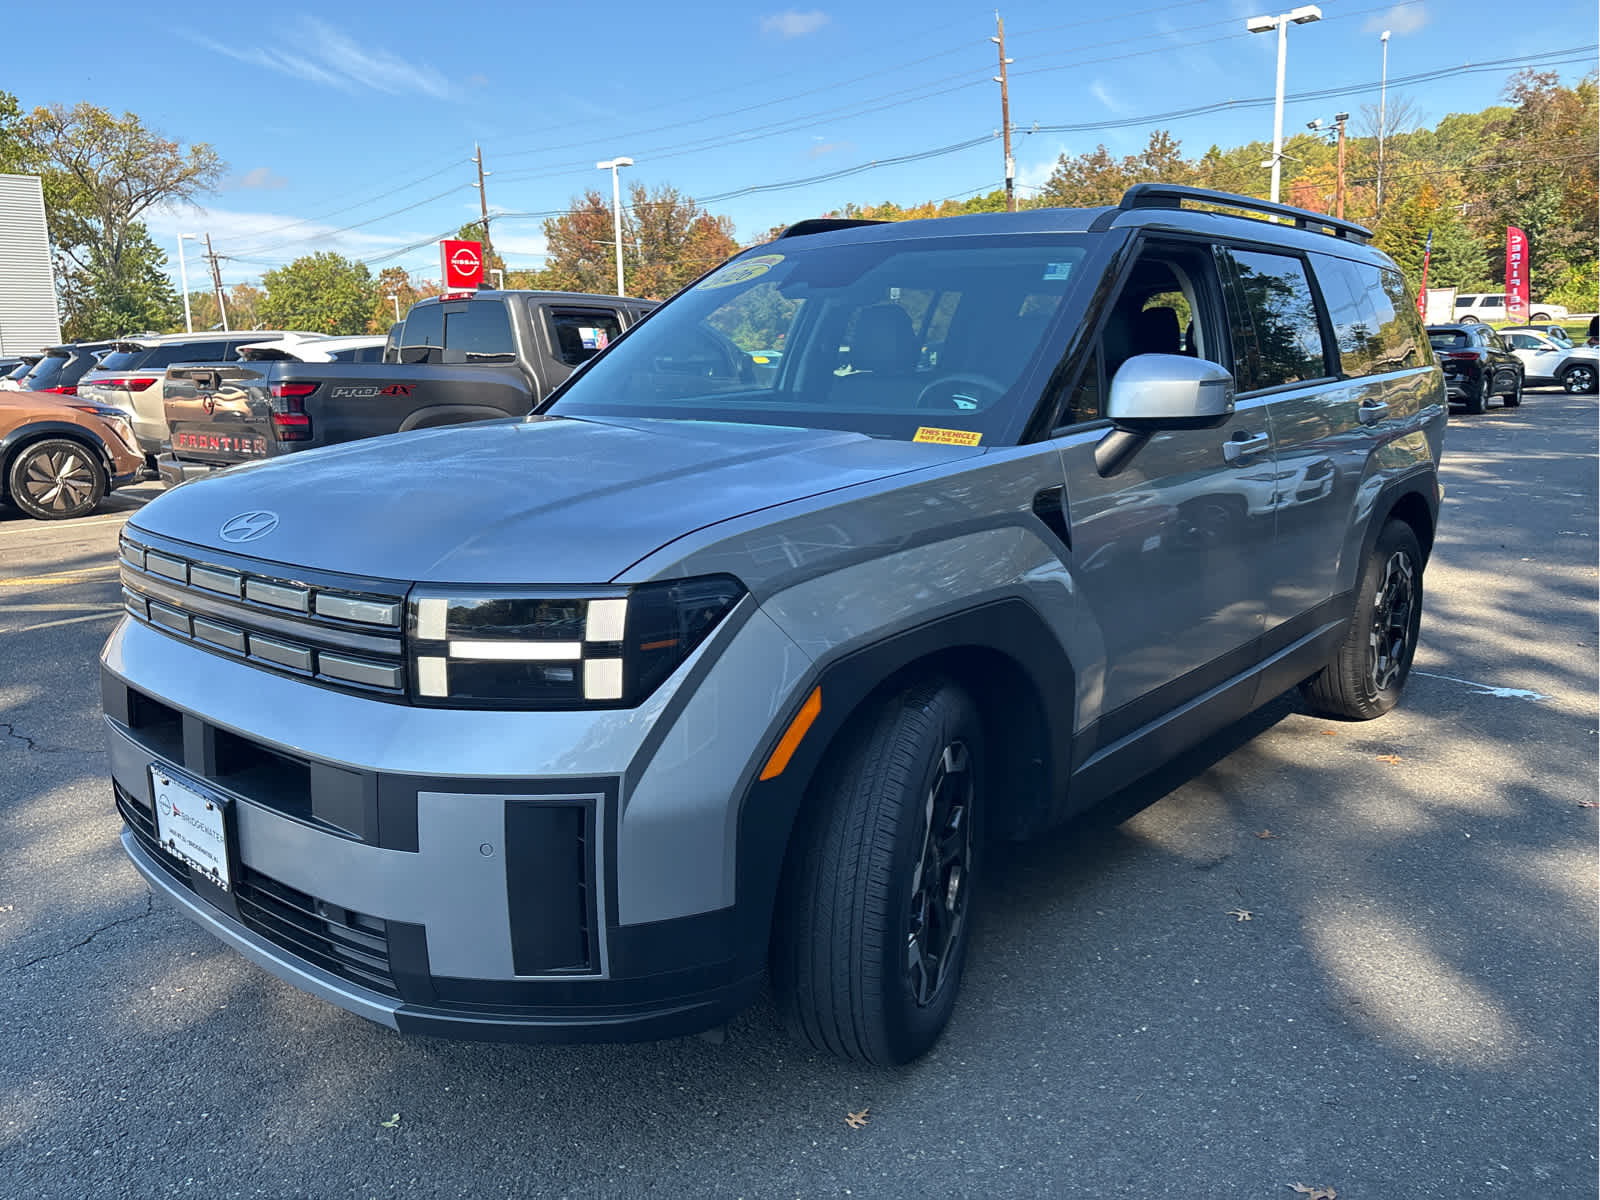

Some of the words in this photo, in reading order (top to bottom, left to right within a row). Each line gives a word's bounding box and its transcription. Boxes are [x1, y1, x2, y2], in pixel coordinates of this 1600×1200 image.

[919, 428, 940, 437] THIS
[941, 430, 977, 440] VEHICLE
[179, 433, 266, 455] FRONTIER
